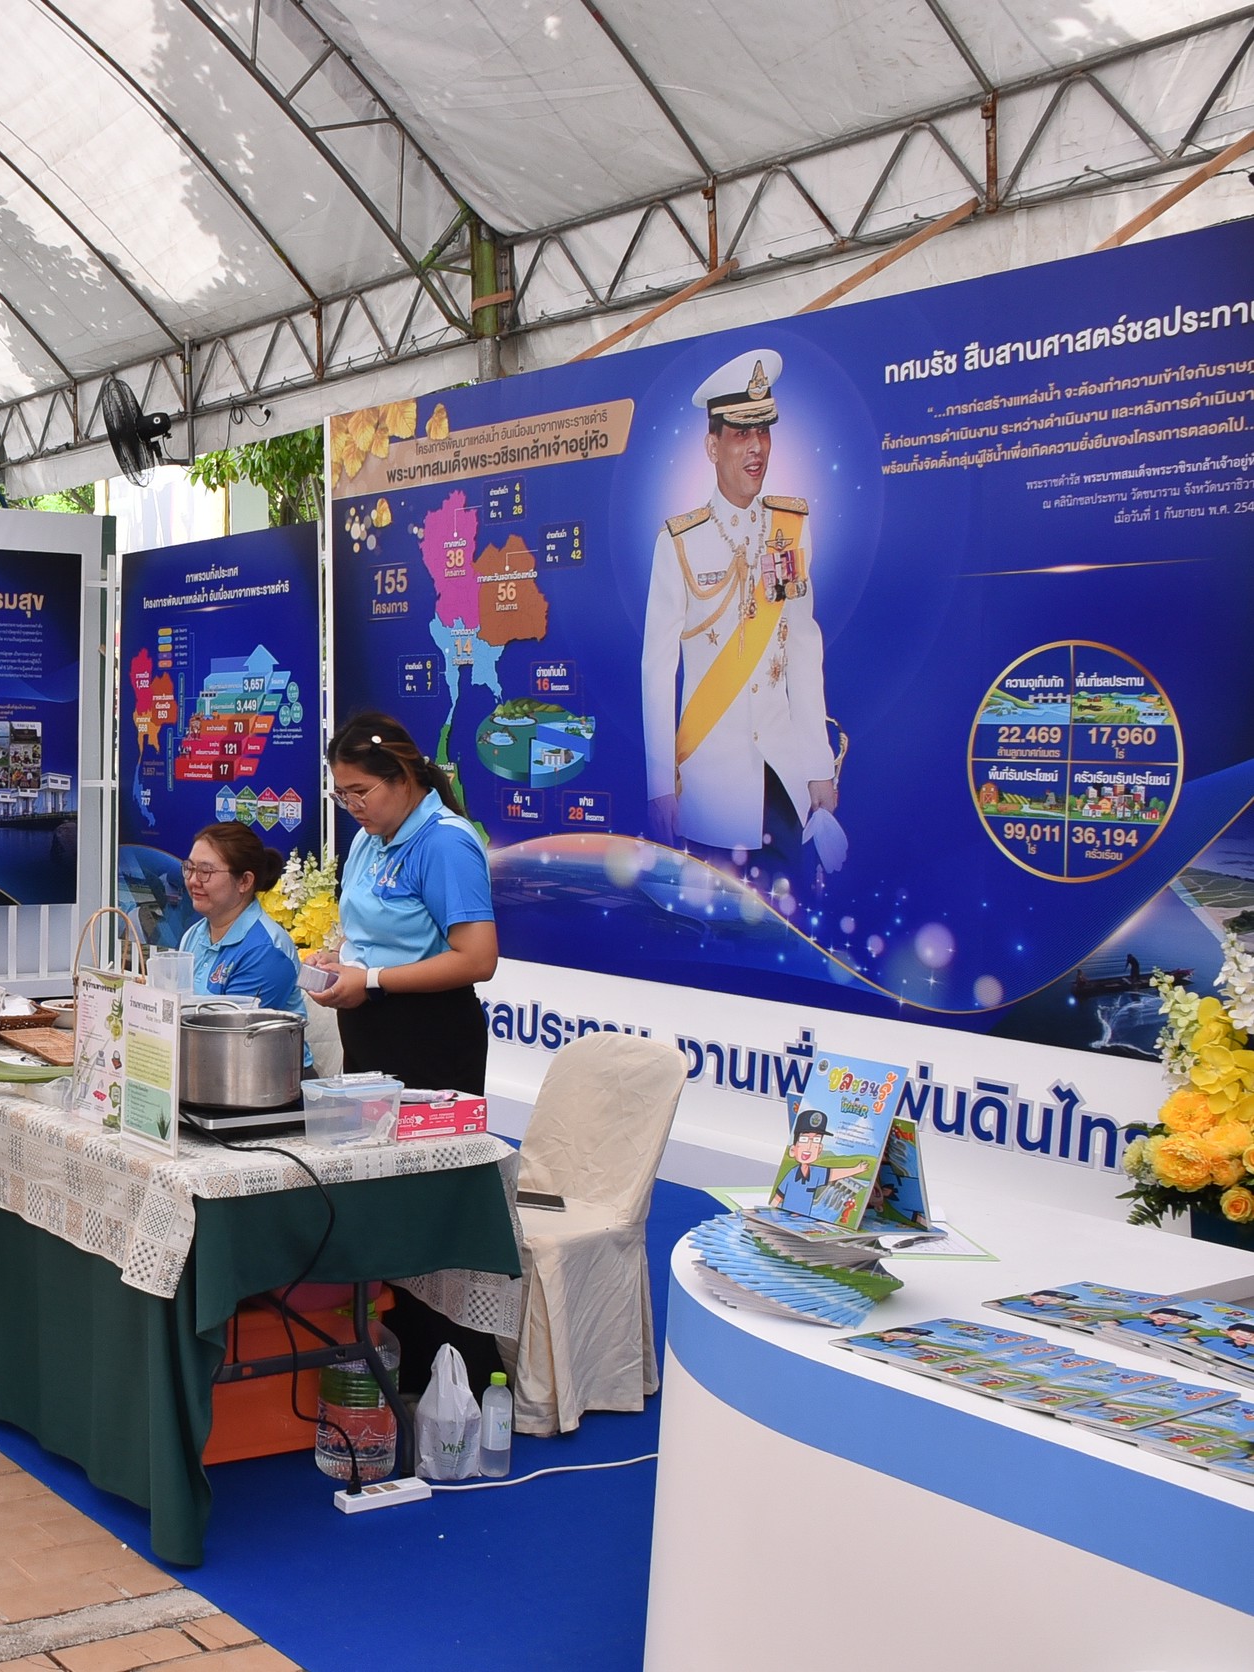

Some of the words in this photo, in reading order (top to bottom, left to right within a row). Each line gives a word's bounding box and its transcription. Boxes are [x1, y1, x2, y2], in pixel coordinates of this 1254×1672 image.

[884, 350, 957, 384] ทศมรัช
[881, 424, 998, 451] ทั้งก่อนการดำเนินงาน
[1001, 409, 1108, 436] ระหว่างดำเนินงาน
[386, 430, 609, 483] พระบาทสมเด็จพระวชิรเกล้าเจ้าอยู่หัว
[514, 482, 520, 491] 4
[514, 494, 520, 503] 8
[512, 505, 523, 515] 26
[1154, 511, 1160, 520] 1
[1163, 505, 1205, 520] กันยายน
[573, 526, 580, 536] 6
[573, 538, 579, 547] 8
[446, 549, 465, 567] 38
[570, 550, 581, 560] 42
[374, 568, 408, 595] 155
[497, 582, 516, 601] 56
[372, 600, 408, 615] โครงการ
[454, 637, 473, 656] 14
[426, 660, 432, 669] 6
[536, 663, 567, 678] อ่างเก็บน้ำ
[427, 671, 431, 680] 1
[1005, 674, 1064, 691] ความจุเก็บกัก
[1075, 671, 1144, 687] พื้นที่ชลประทาน
[243, 678, 264, 693] 3,657
[427, 682, 432, 690] 7
[536, 679, 550, 691] 16
[236, 699, 257, 713] 3,449
[234, 721, 243, 734] 70
[998, 726, 1062, 743] 22.469
[1088, 727, 1157, 747] 17,960
[224, 743, 237, 755] 121
[1115, 747, 1125, 759] ไร่
[219, 764, 229, 775] 17
[988, 766, 1059, 782] พื้นที่รับประโยชน์
[1074, 770, 1171, 786] ครัวเรือนรับประโยชน์
[507, 804, 521, 817] 111
[568, 807, 584, 820] 28
[1003, 822, 1060, 844] 99,011
[1072, 826, 1138, 848] 36,194
[1027, 842, 1037, 855] ไร่
[1085, 849, 1123, 861] ครัวเรือน
